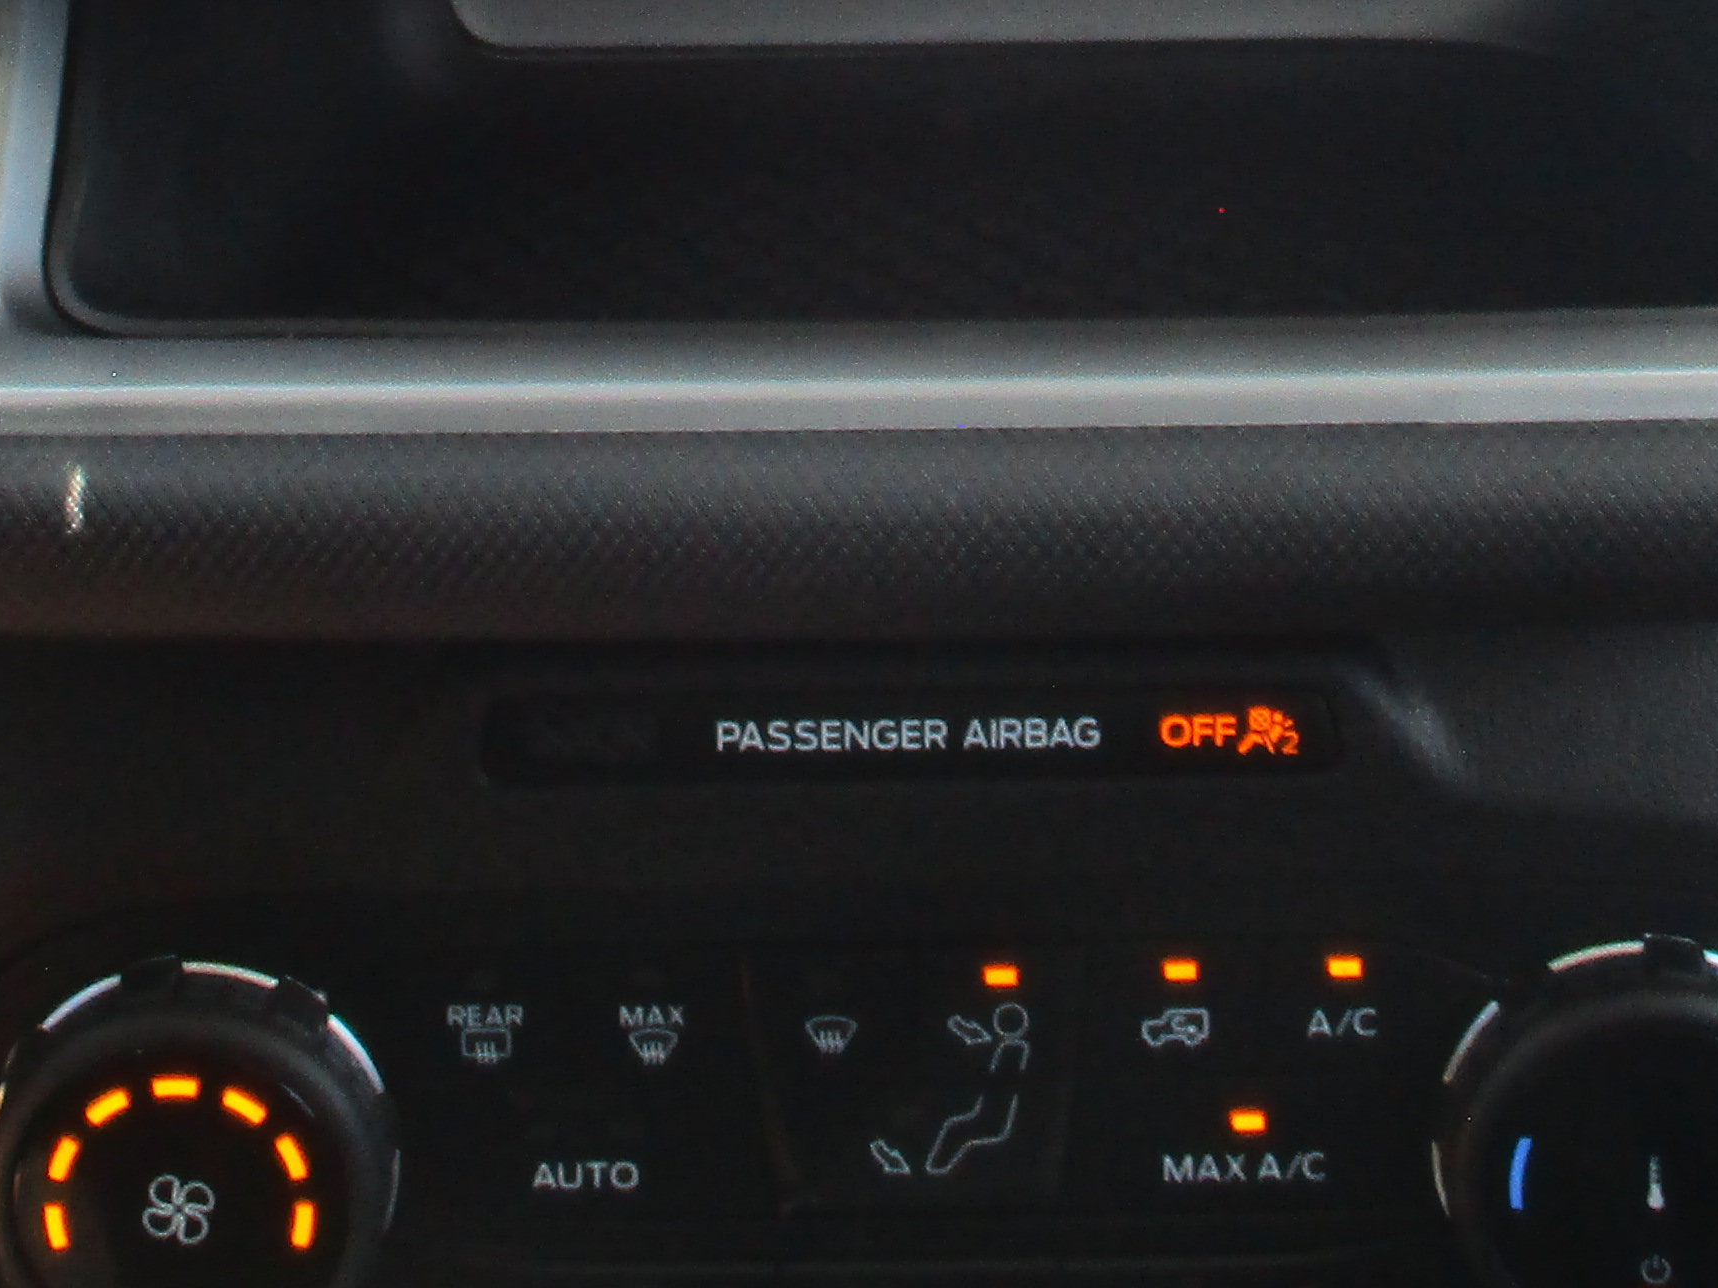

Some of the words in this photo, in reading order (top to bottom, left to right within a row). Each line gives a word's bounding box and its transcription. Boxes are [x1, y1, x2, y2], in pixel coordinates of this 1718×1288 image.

[715, 719, 948, 753] PASSENGER
[963, 717, 1101, 750] AIRBAG
[1159, 714, 1238, 748] OFF
[447, 1005, 523, 1026] REAR
[619, 1005, 684, 1026] MAX
[1307, 1008, 1377, 1037] A/C
[533, 1161, 639, 1191] AUTO
[1162, 1155, 1246, 1183] MAX
[1259, 1153, 1326, 1182] A/C
